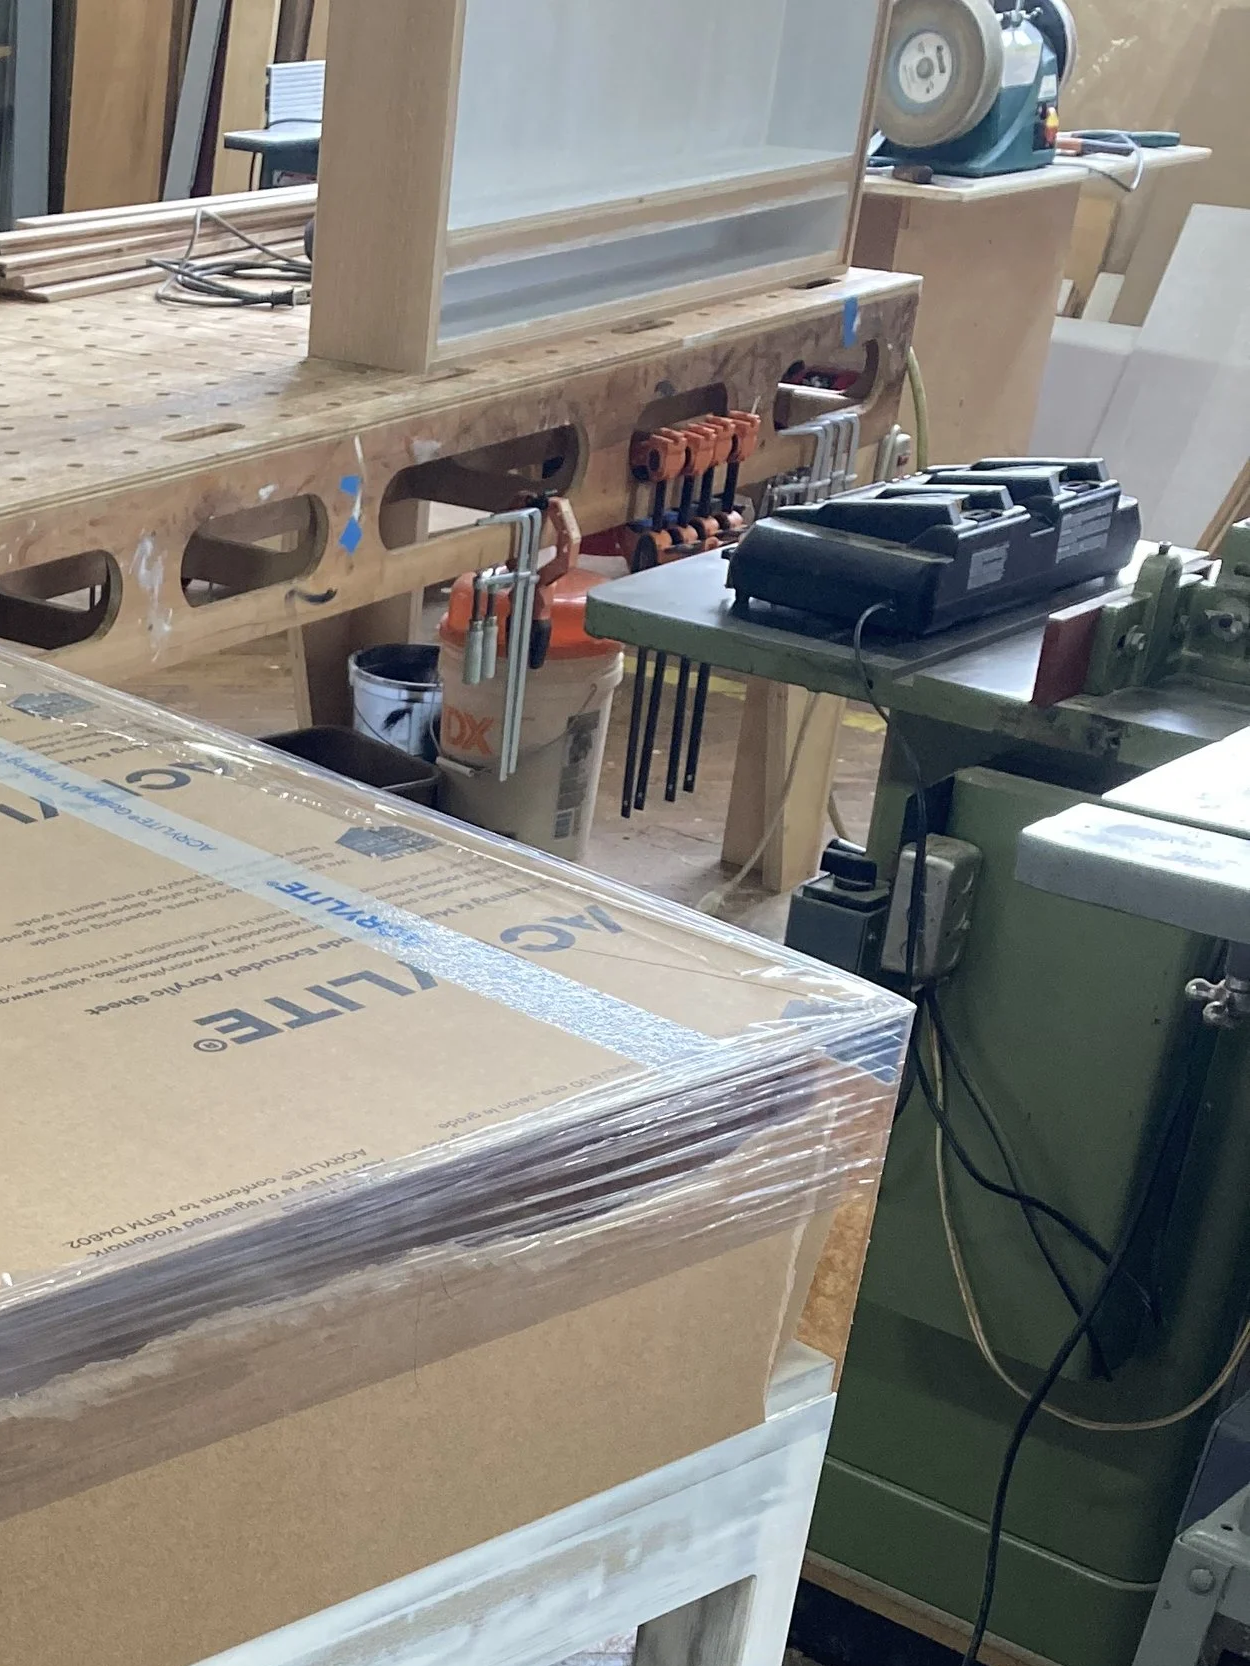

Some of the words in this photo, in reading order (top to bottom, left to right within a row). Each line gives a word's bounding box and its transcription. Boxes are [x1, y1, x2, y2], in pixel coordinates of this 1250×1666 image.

[223, 946, 318, 977] Extruded
[149, 972, 222, 997] Acrylic
[193, 905, 623, 1053] ACYLITE®
[83, 994, 150, 1015] Sheet
[198, 1177, 276, 1204] conforms
[125, 1208, 176, 1230] ASTM
[178, 1202, 200, 1211] to
